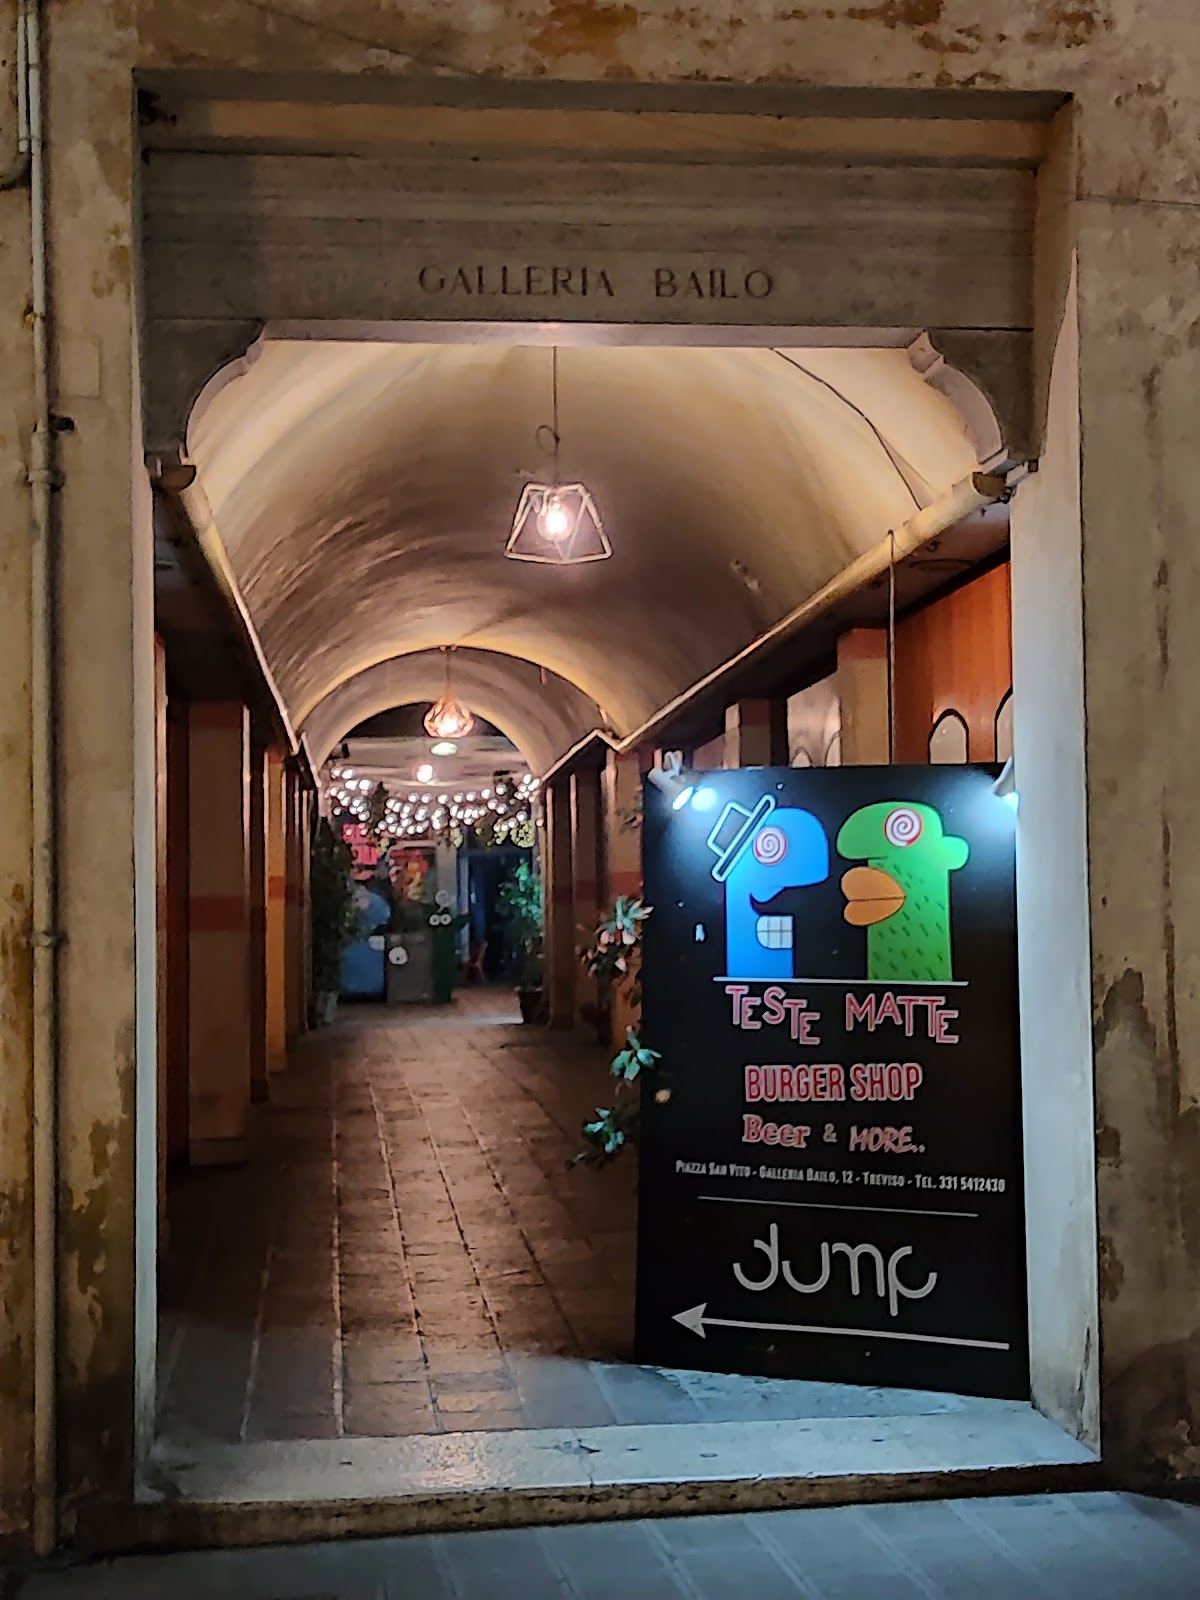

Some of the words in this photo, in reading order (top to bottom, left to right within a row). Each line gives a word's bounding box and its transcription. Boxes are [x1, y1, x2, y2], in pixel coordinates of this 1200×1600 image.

[418, 264, 614, 297] GALLERIA
[654, 267, 773, 299] BAILO
[725, 985, 821, 1045] TESTE
[845, 991, 960, 1044] MATTE
[745, 1064, 846, 1102] BURGER
[850, 1063, 922, 1101] SHOP
[742, 1114, 811, 1148] Beer
[823, 1123, 838, 1143] &
[842, 1170, 854, 1184] 12
[939, 1175, 958, 1190] 331
[960, 1176, 1006, 1193] 5412430
[733, 1223, 937, 1317] dump
